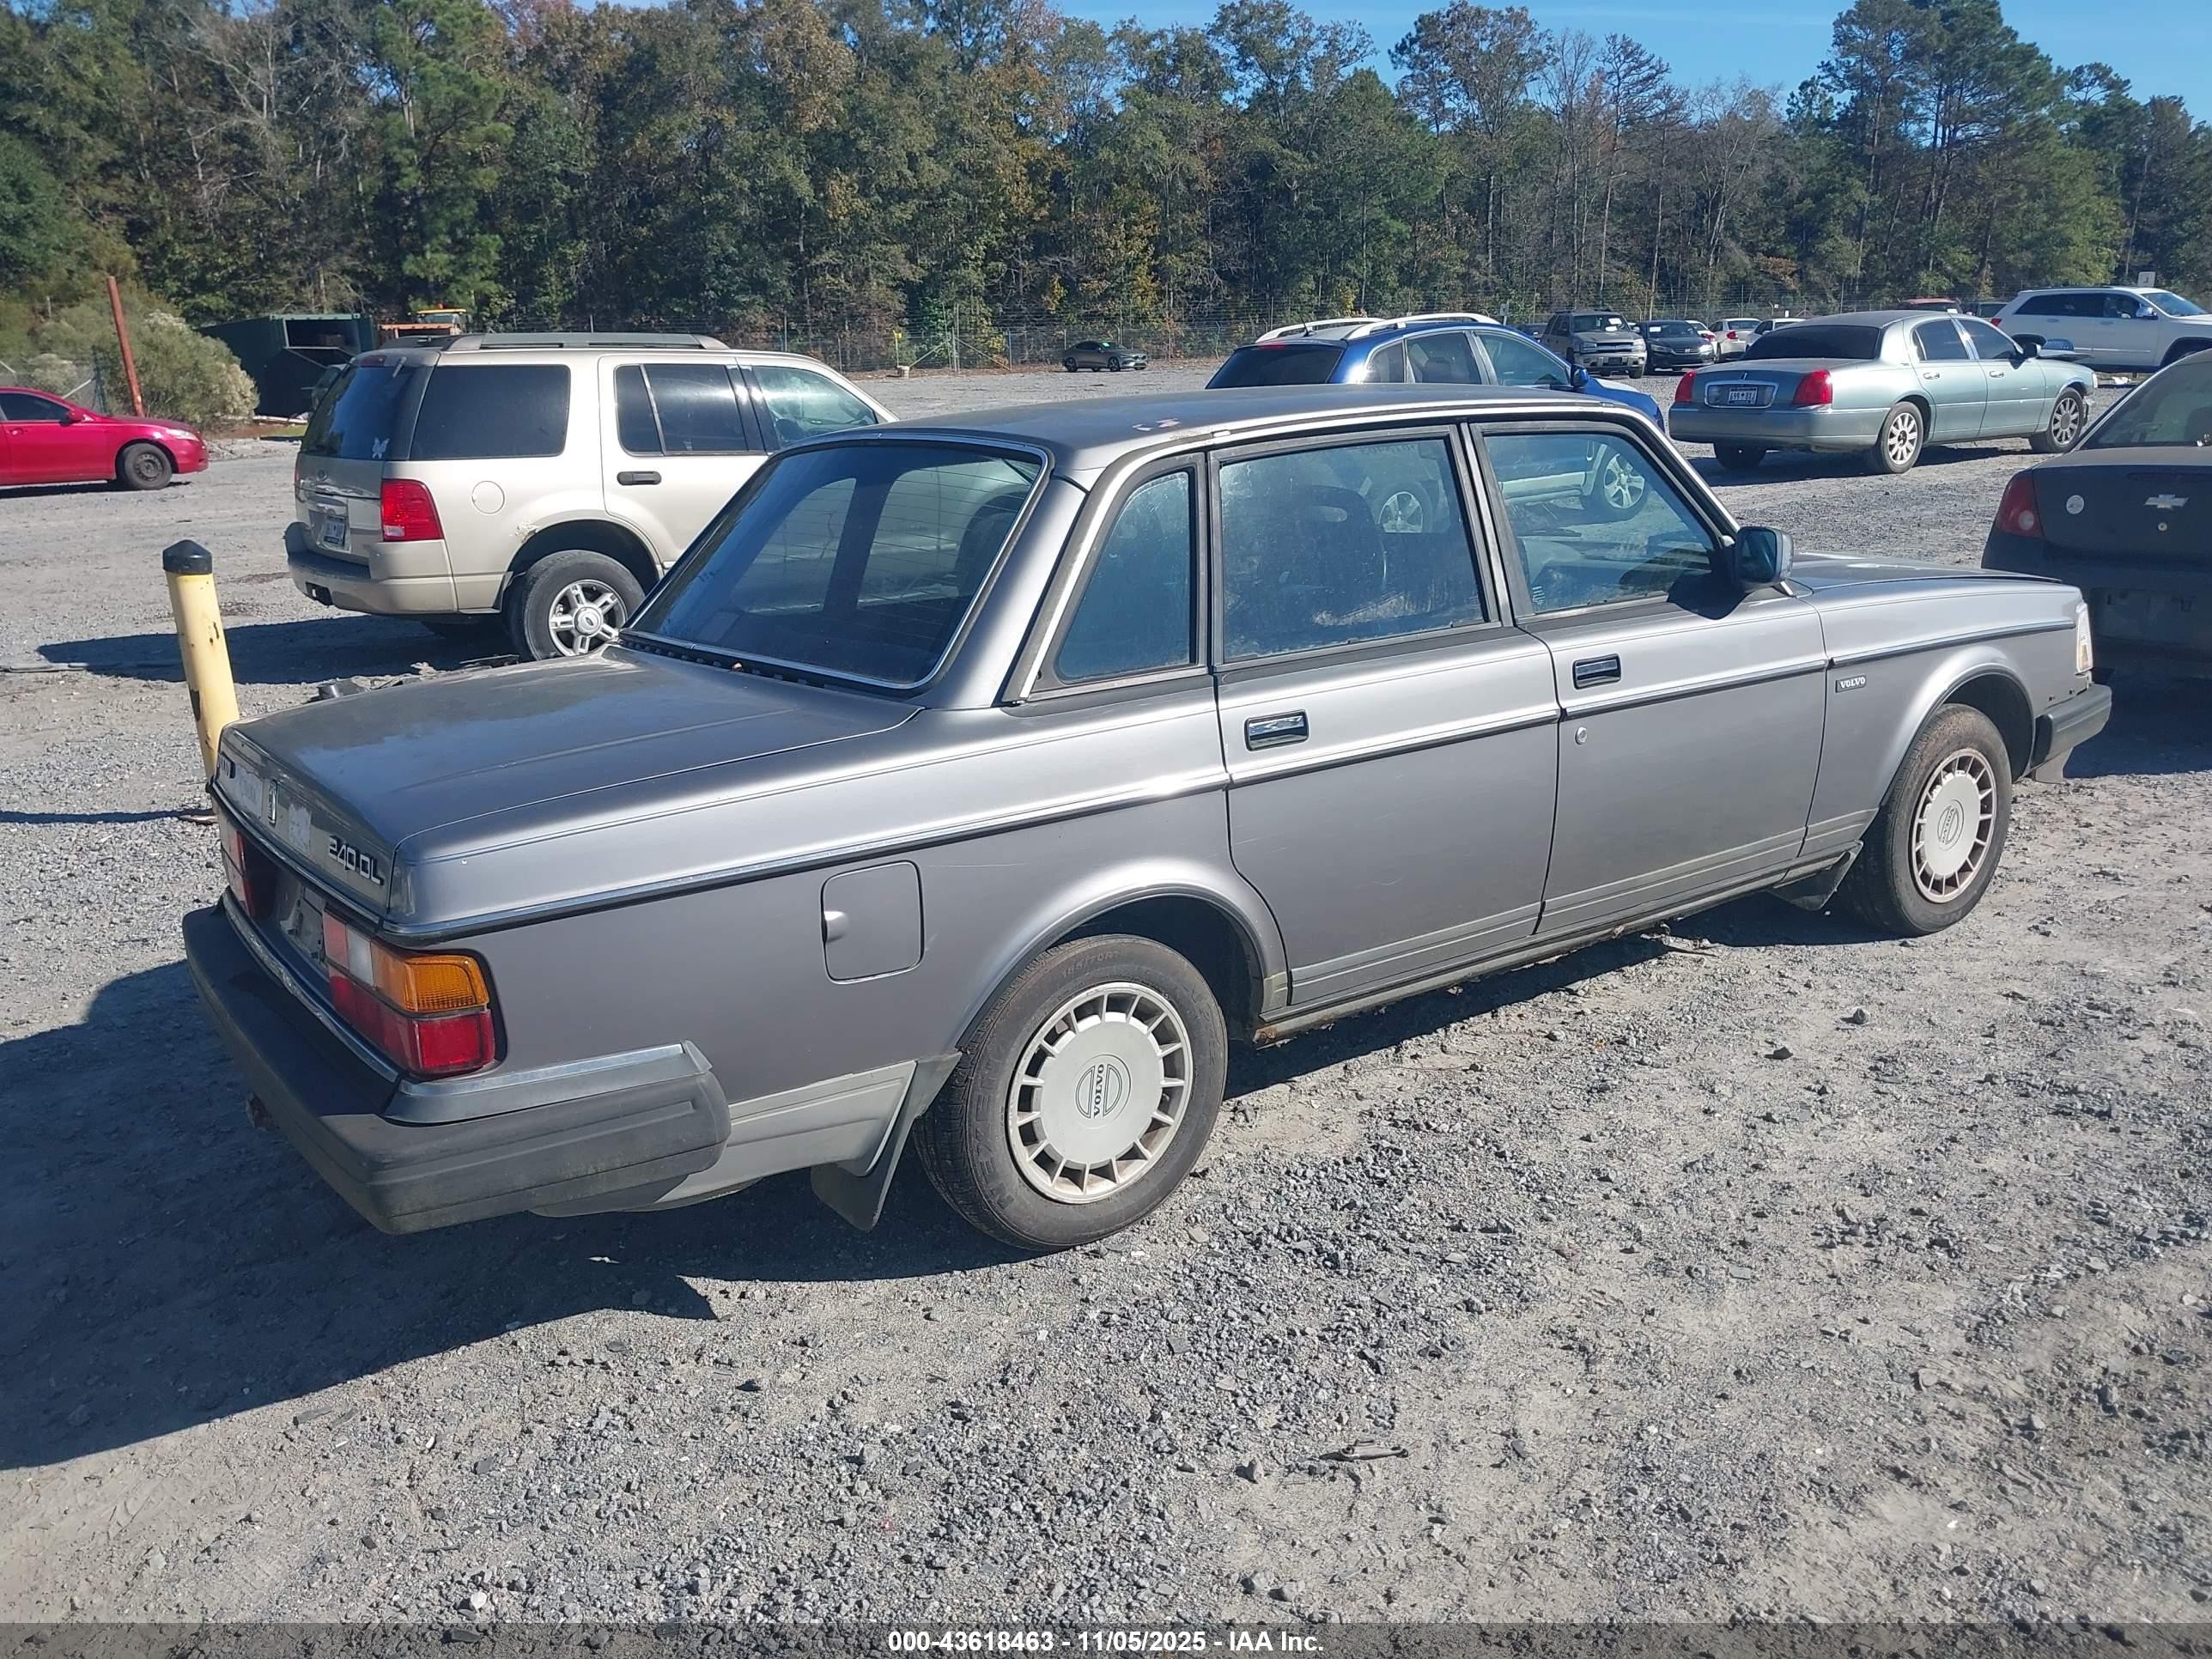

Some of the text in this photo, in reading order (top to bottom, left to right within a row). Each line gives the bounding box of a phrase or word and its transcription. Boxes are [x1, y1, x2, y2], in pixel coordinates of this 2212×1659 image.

[1840, 677, 1866, 689] VOLVO
[329, 836, 382, 885] 240 DL
[1093, 1064, 1105, 1119] VOLVO
